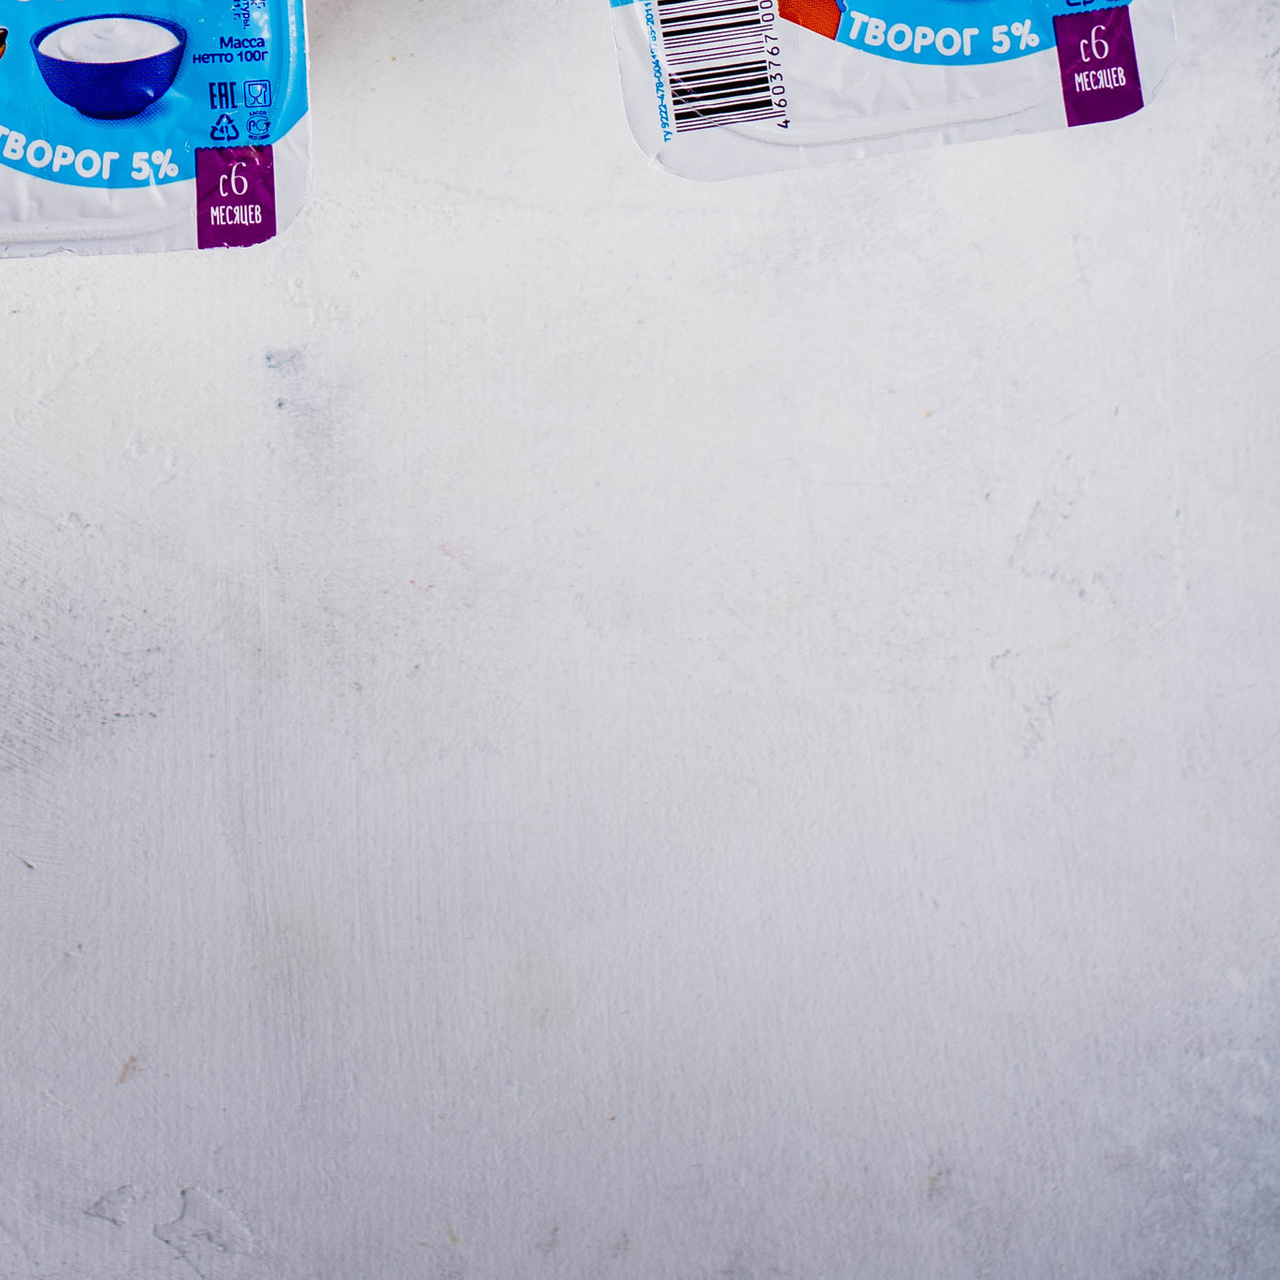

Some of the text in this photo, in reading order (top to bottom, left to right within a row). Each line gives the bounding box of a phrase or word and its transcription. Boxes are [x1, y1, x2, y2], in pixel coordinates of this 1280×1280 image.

[220, 36, 265, 50] Масса
[849, 11, 1040, 57] ТВОРОГ 5%
[192, 50, 268, 64] нетто 100г
[764, 33, 788, 108] 603767
[1074, 66, 1127, 92] МЕСЯЦЕВ
[776, 117, 791, 128] 4
[130, 148, 180, 180] 5%
[210, 204, 262, 226] МЕСЯЦЕВ
